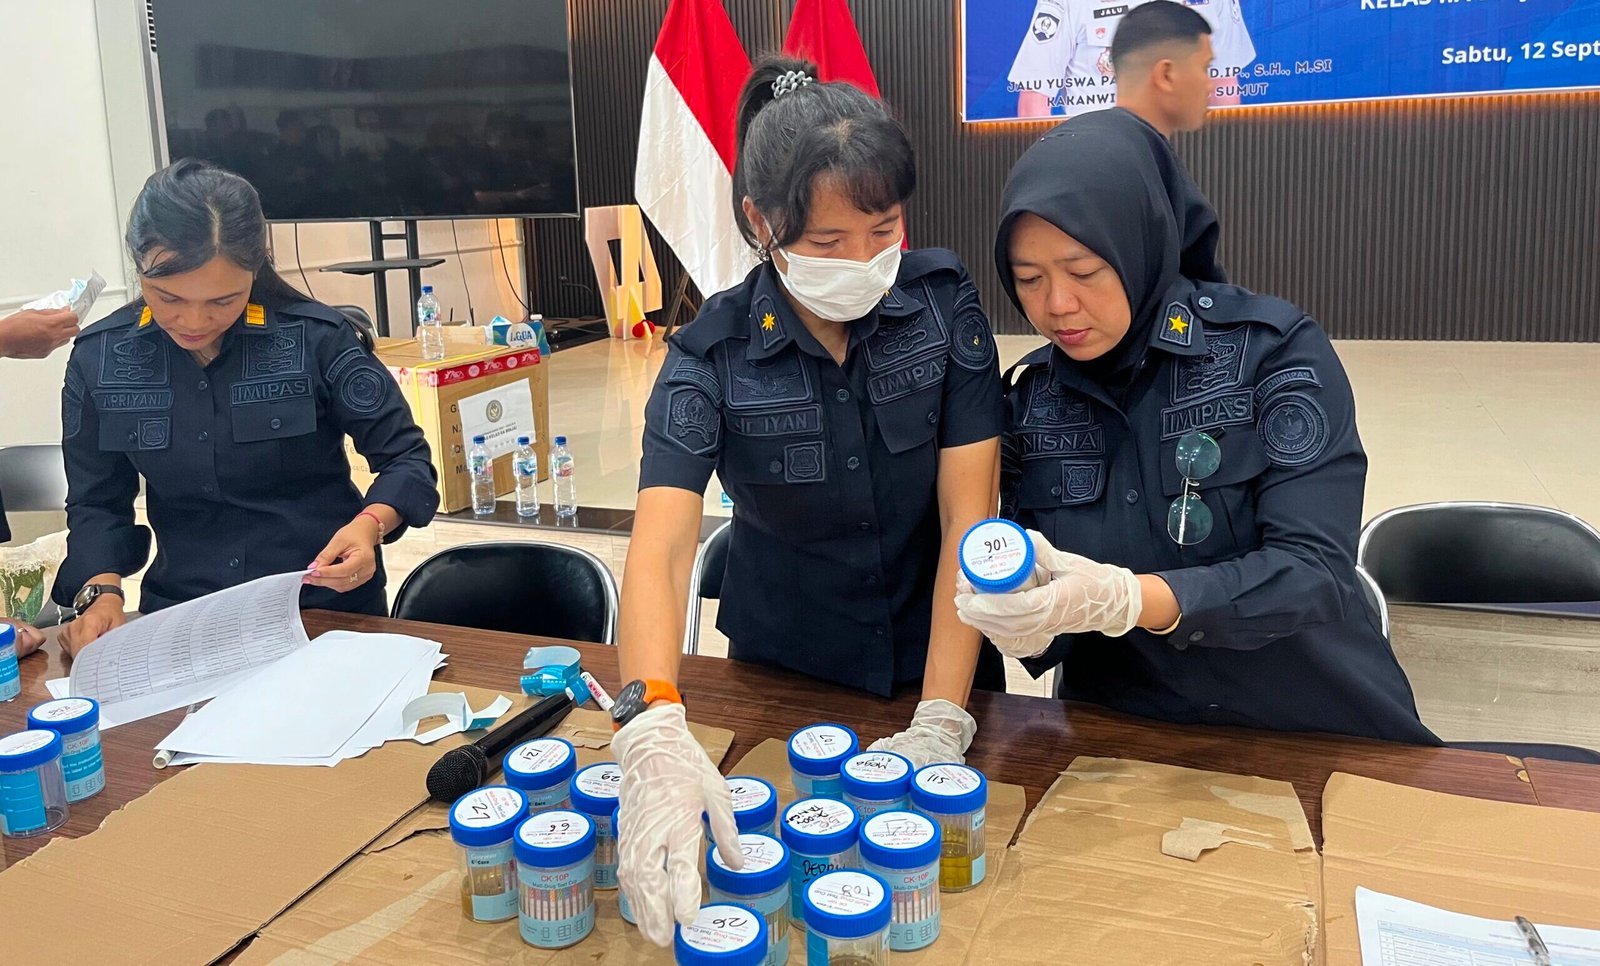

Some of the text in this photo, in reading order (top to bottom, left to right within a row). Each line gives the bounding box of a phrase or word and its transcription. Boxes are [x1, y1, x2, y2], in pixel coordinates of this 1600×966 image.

[1100, 8, 1123, 16] JALU
[1441, 46, 1513, 64] Sabtu,
[1520, 42, 1546, 60] 12
[1007, 80, 1042, 92] JALU
[1046, 77, 1096, 89] YUSWA
[1216, 83, 1268, 97] SUMUT
[234, 380, 306, 400] IMIPAS
[1169, 398, 1248, 432] IMIPAS
[1023, 432, 1097, 453] NISNA
[984, 536, 1008, 553] 106
[523, 747, 543, 761] 121
[540, 873, 570, 882] CK-10P
[903, 871, 929, 884] CK-10P
[712, 917, 748, 929] 26
